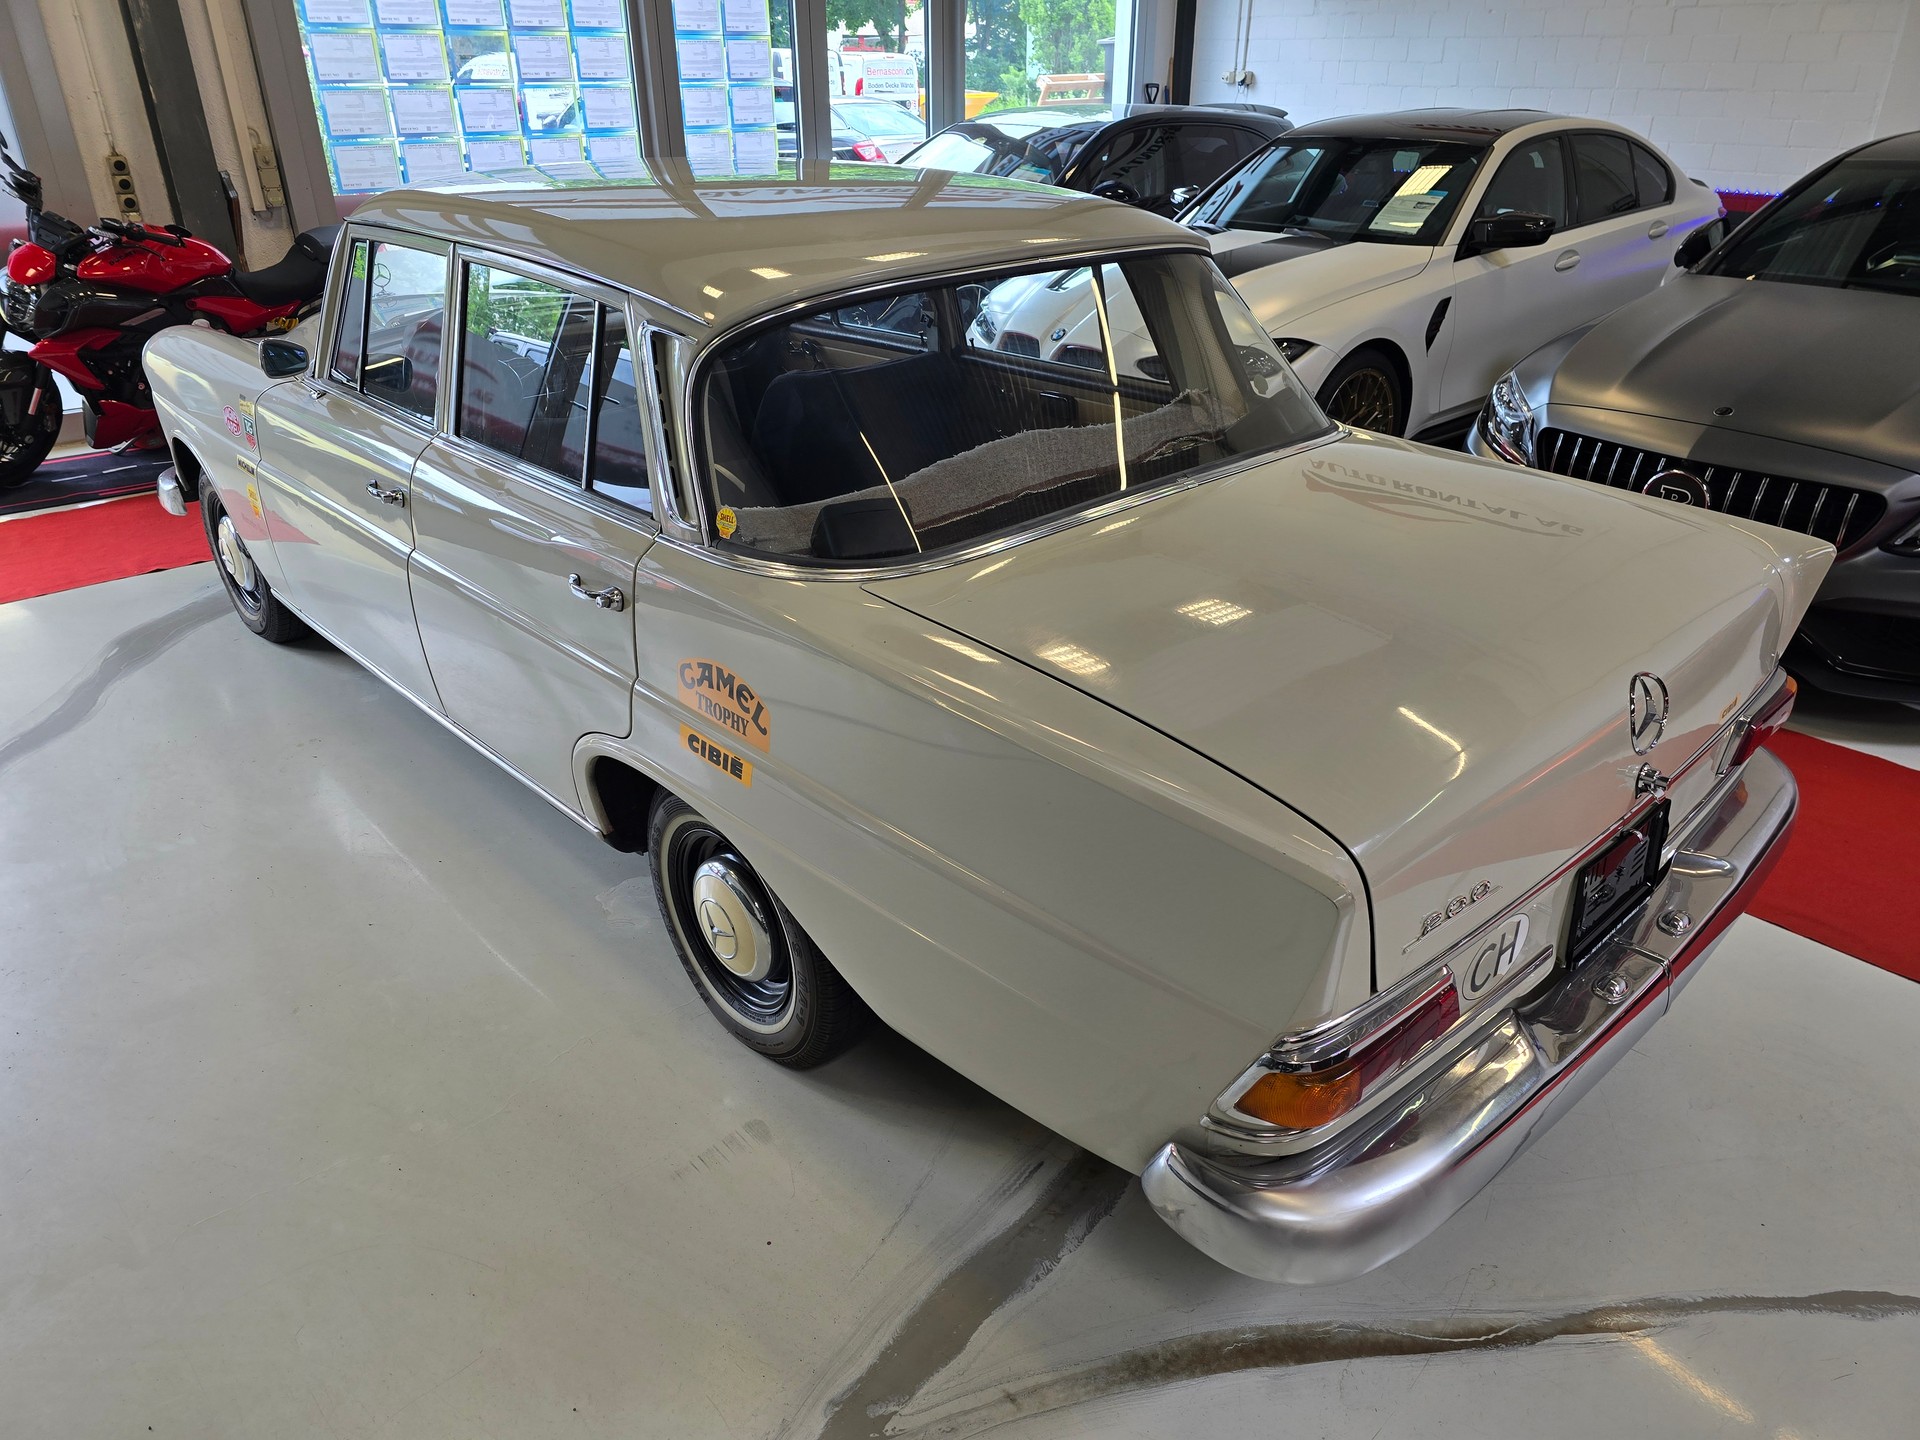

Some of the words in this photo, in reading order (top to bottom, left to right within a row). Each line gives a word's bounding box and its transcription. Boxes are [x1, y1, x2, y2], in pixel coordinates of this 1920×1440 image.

[720, 512, 734, 524] SHELL
[679, 661, 768, 736] CAMEL
[695, 690, 750, 737] TROPHY
[1470, 919, 1522, 993] CH
